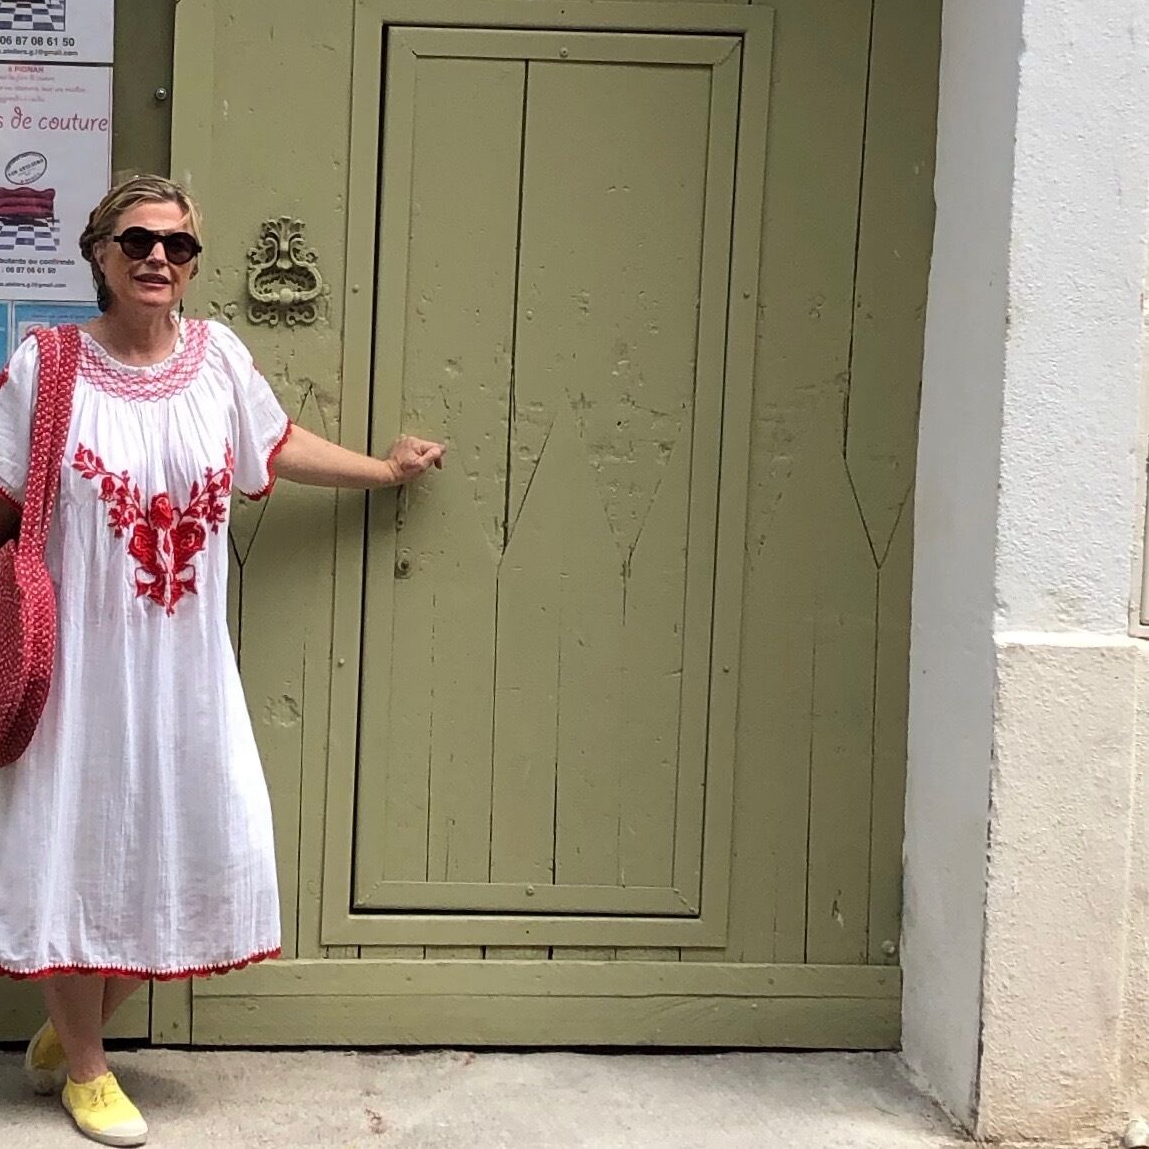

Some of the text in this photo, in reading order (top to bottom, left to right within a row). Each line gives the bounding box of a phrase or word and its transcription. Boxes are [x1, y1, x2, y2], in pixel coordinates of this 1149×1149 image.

[0, 36, 12, 45] 06
[15, 36, 28, 45] 87
[31, 36, 44, 46] 08
[46, 37, 58, 46] 61
[62, 37, 75, 47] 50
[11, 106, 32, 129] de
[38, 113, 109, 132] couture
